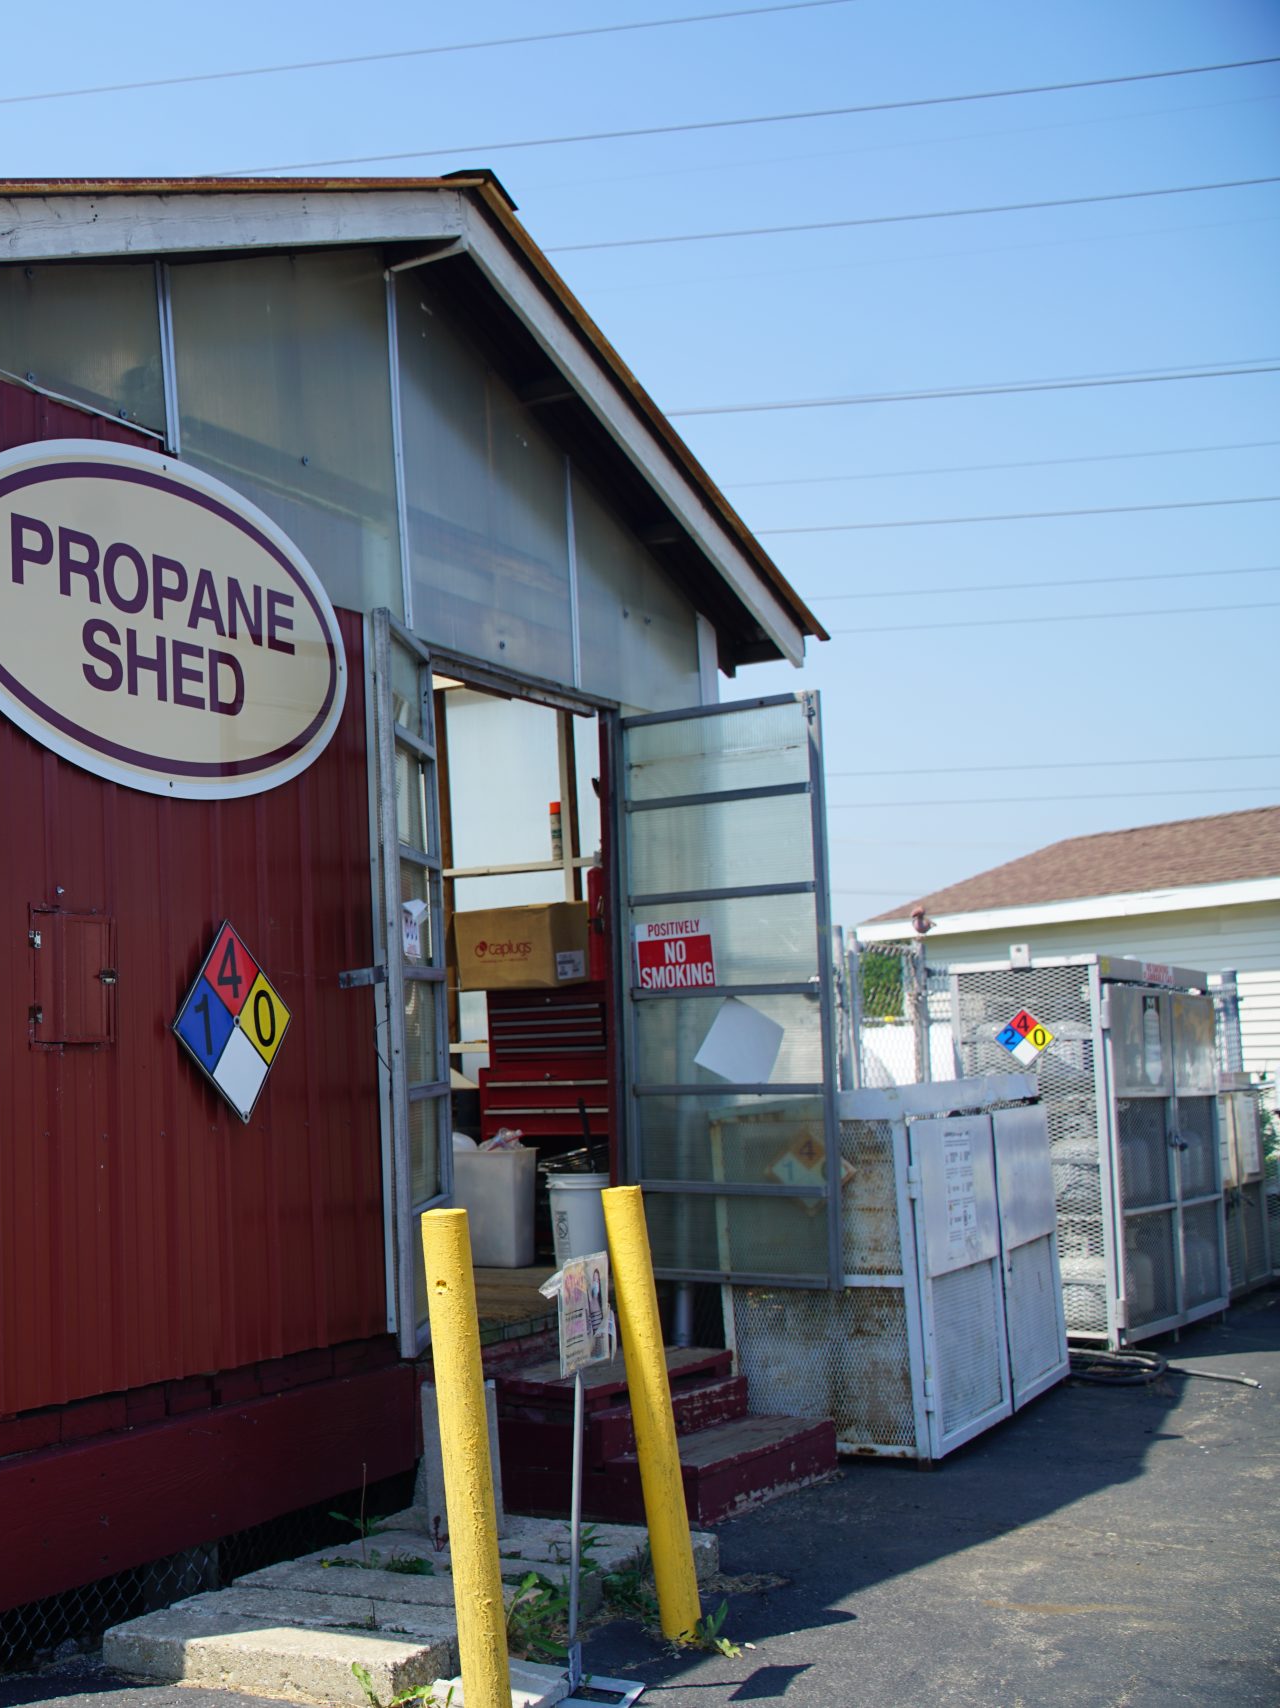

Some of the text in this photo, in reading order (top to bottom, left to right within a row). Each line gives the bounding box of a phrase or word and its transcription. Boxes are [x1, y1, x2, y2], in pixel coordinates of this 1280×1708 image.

[10, 512, 296, 656] PROPANE
[82, 618, 245, 717] SHED
[647, 919, 700, 937] POSITIVELY
[488, 940, 532, 957] caplugs
[664, 940, 686, 964] NO
[217, 937, 242, 998] 4
[641, 961, 714, 989] SMOKING
[194, 989, 276, 1056] 1 0
[1016, 1015, 1029, 1032] 4
[1004, 1028, 1046, 1046] 2 0
